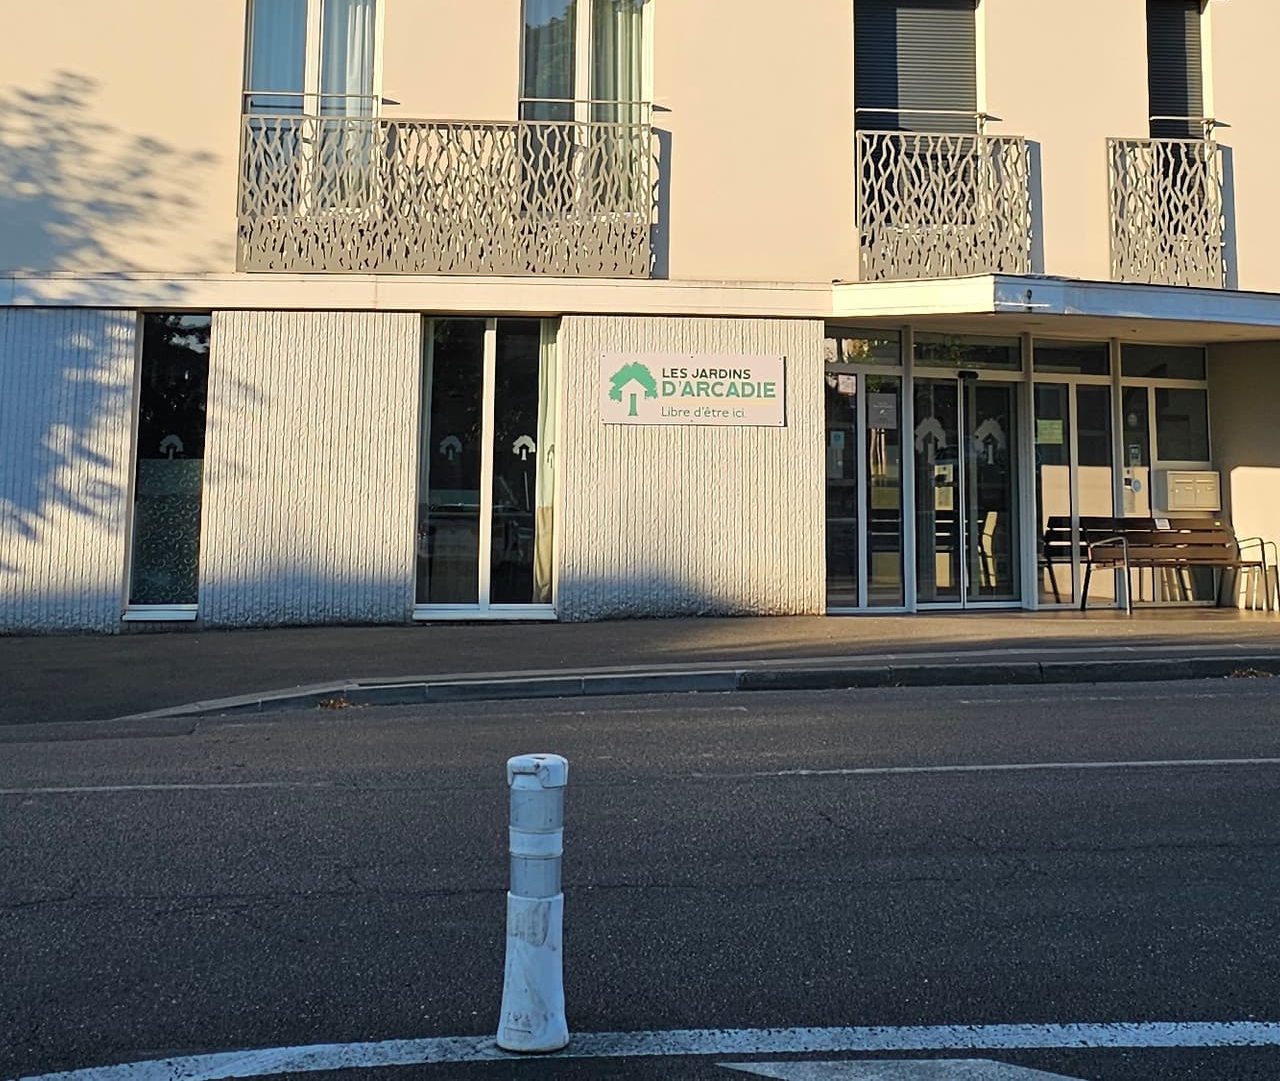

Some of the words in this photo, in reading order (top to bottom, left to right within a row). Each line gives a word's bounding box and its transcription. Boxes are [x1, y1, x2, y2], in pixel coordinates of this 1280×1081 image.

[662, 368, 688, 379] LES
[691, 368, 751, 379] JARDINS
[662, 381, 776, 398] D'ARCADIE
[661, 407, 690, 417] Libre
[694, 407, 729, 418] d'être
[732, 408, 745, 418] ici
